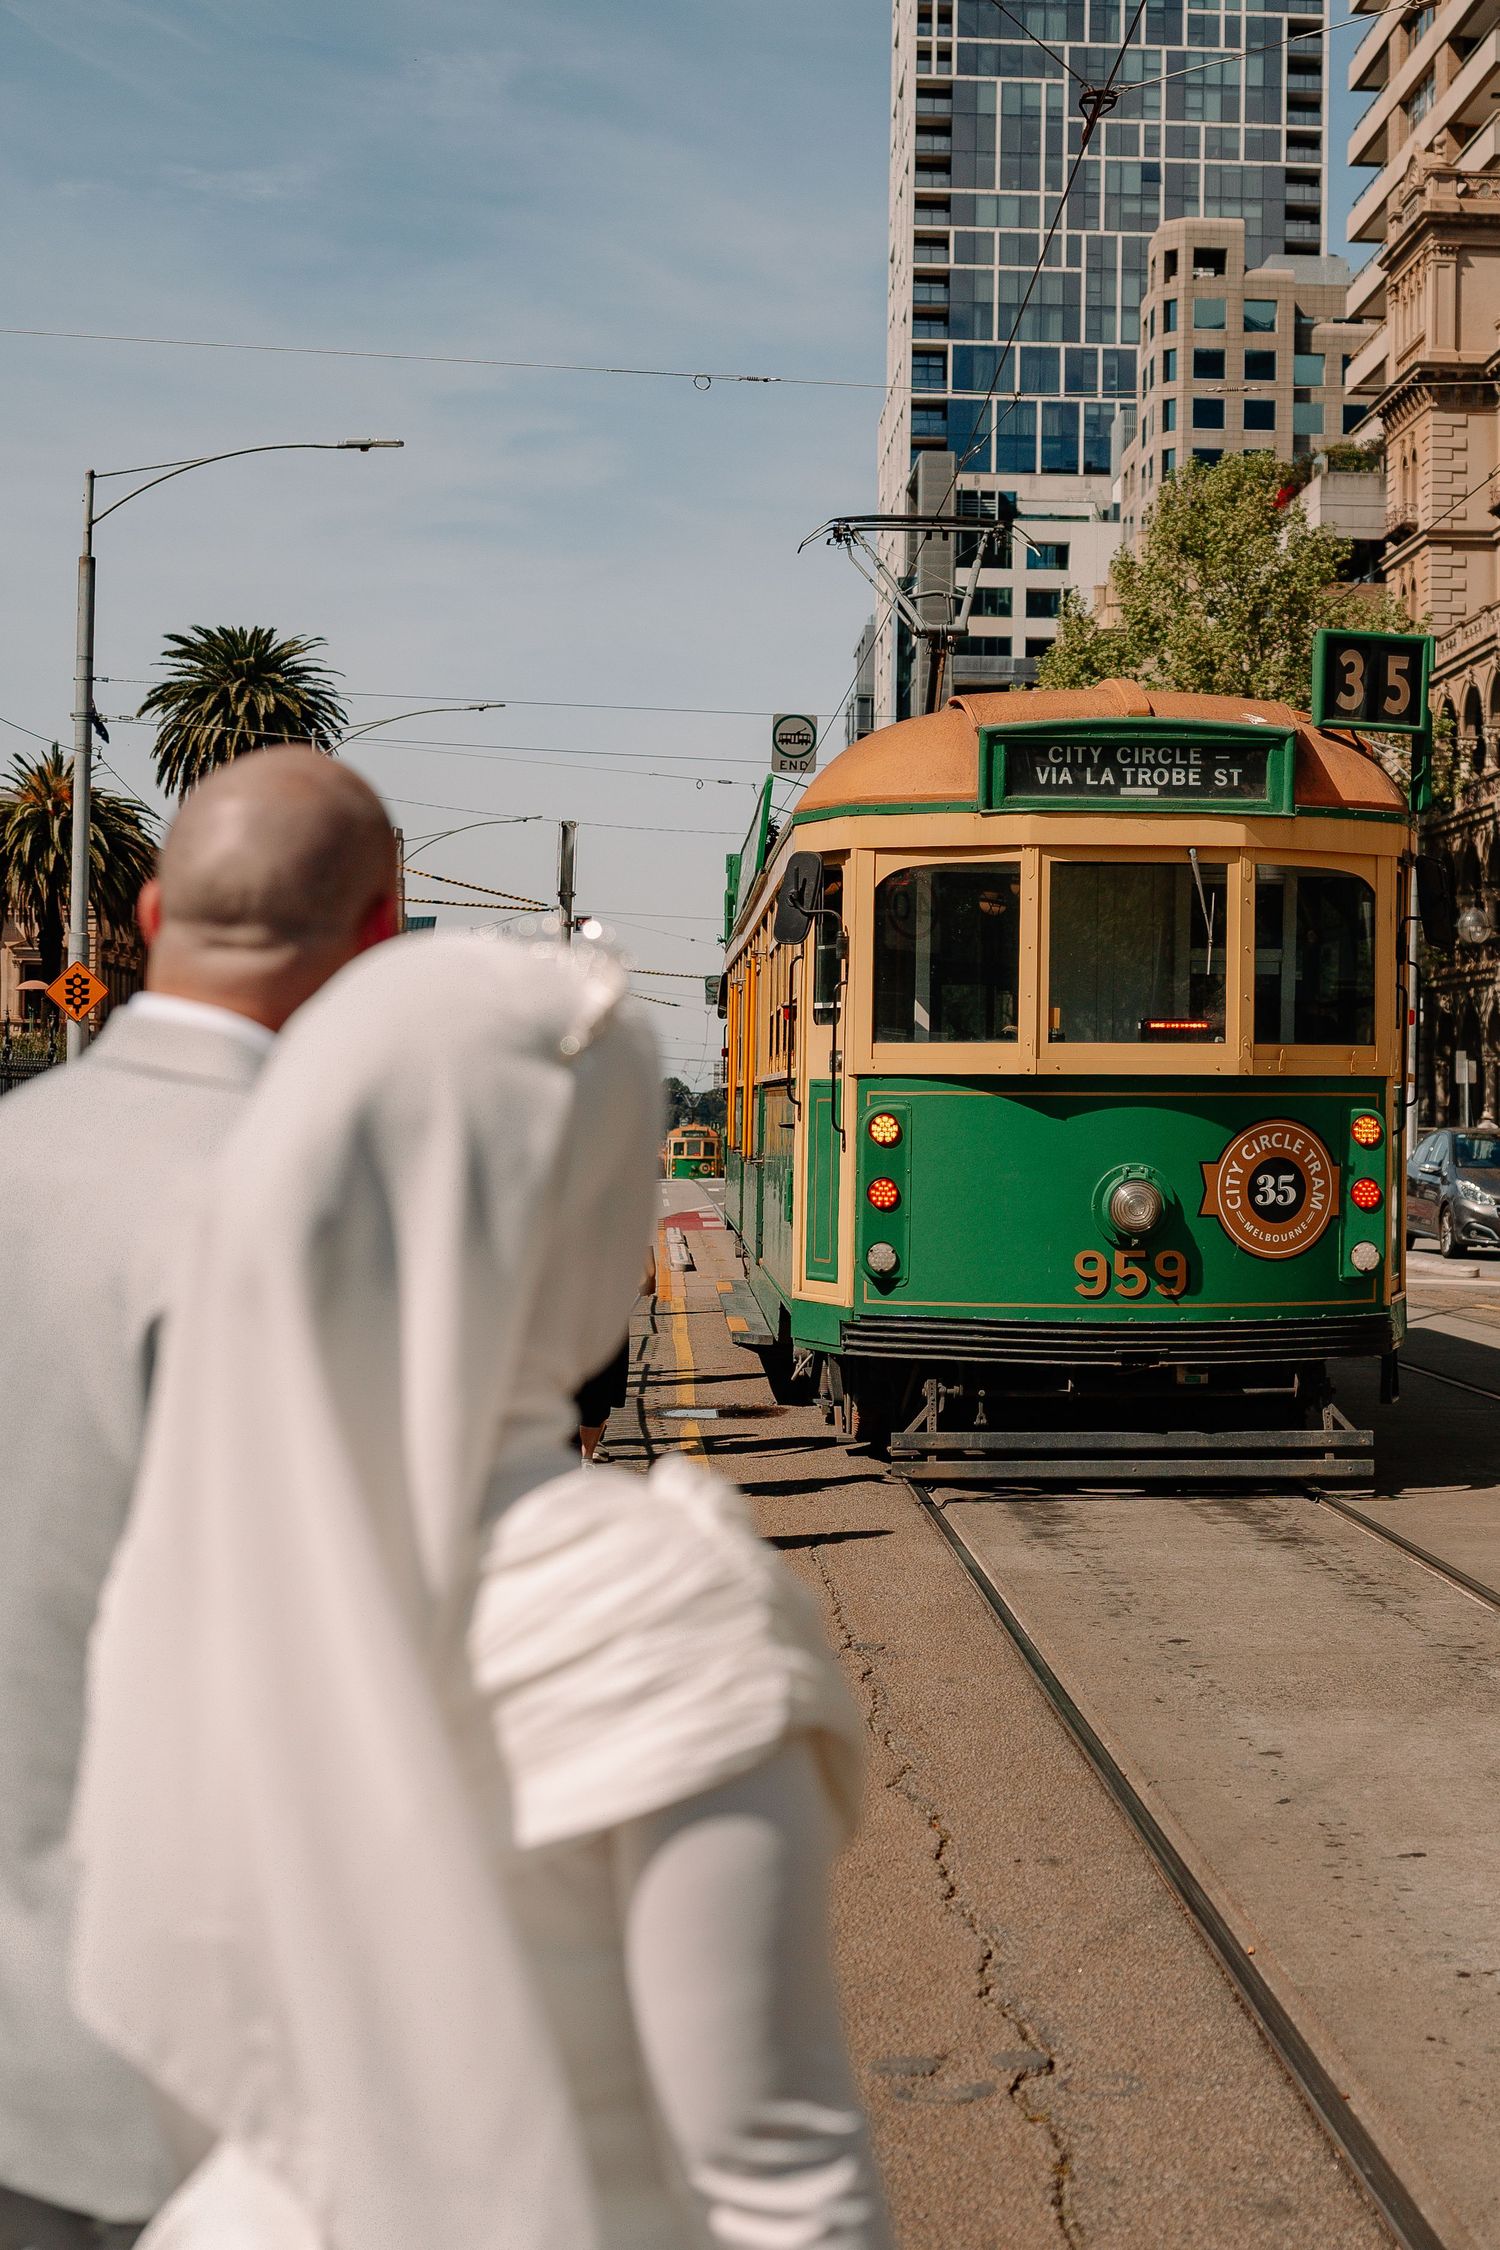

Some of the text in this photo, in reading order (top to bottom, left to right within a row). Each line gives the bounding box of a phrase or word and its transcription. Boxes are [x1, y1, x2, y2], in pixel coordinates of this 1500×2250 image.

[1335, 649, 1411, 715] 35
[780, 760, 809, 771] END
[1047, 746, 1103, 764] CITY
[1116, 747, 1203, 765] CIRCLE
[1035, 766, 1243, 786] VIA LA TROBE ST
[1225, 1132, 1325, 1211] CITY CIRCLE TRAM
[1254, 1173, 1297, 1206] 35
[1243, 1221, 1308, 1243] MELBOURNE
[1073, 1250, 1188, 1298] 959
